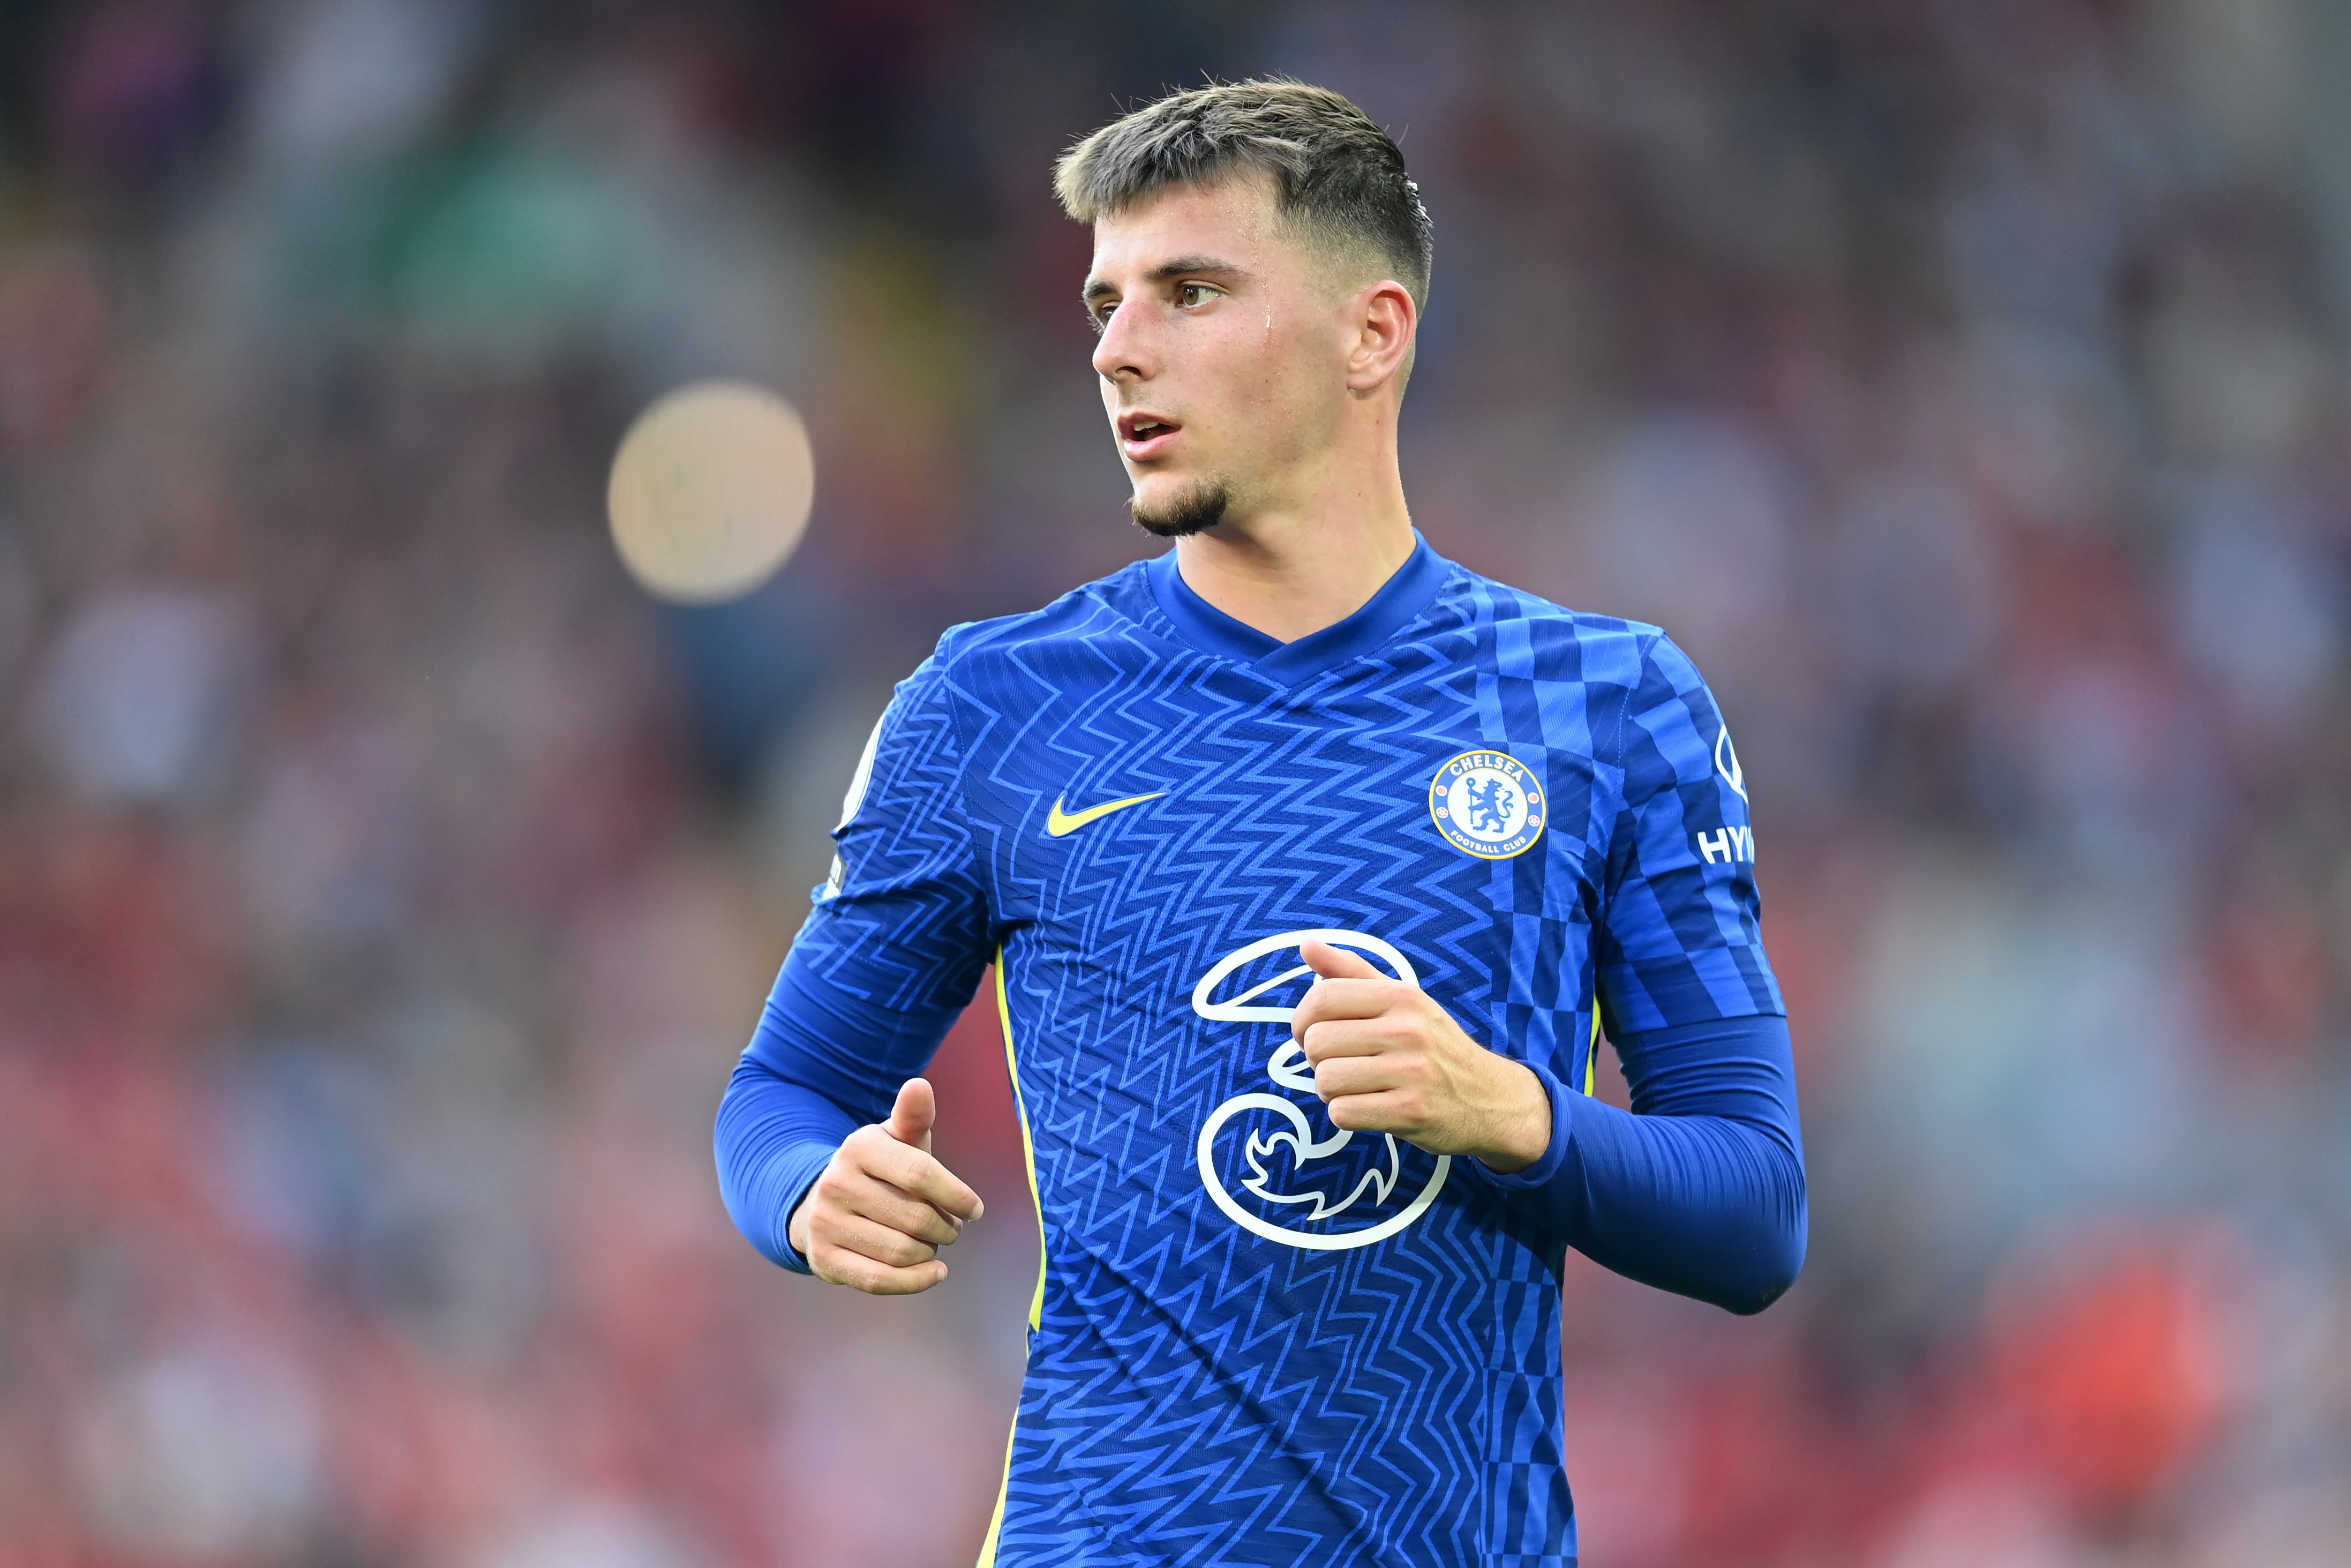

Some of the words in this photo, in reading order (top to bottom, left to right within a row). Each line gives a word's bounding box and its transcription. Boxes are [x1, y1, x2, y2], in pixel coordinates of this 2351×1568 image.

[1449, 754, 1524, 783] CHELSEA
[1450, 830, 1500, 853] FOOTBALL
[1503, 836, 1527, 852] CLUB
